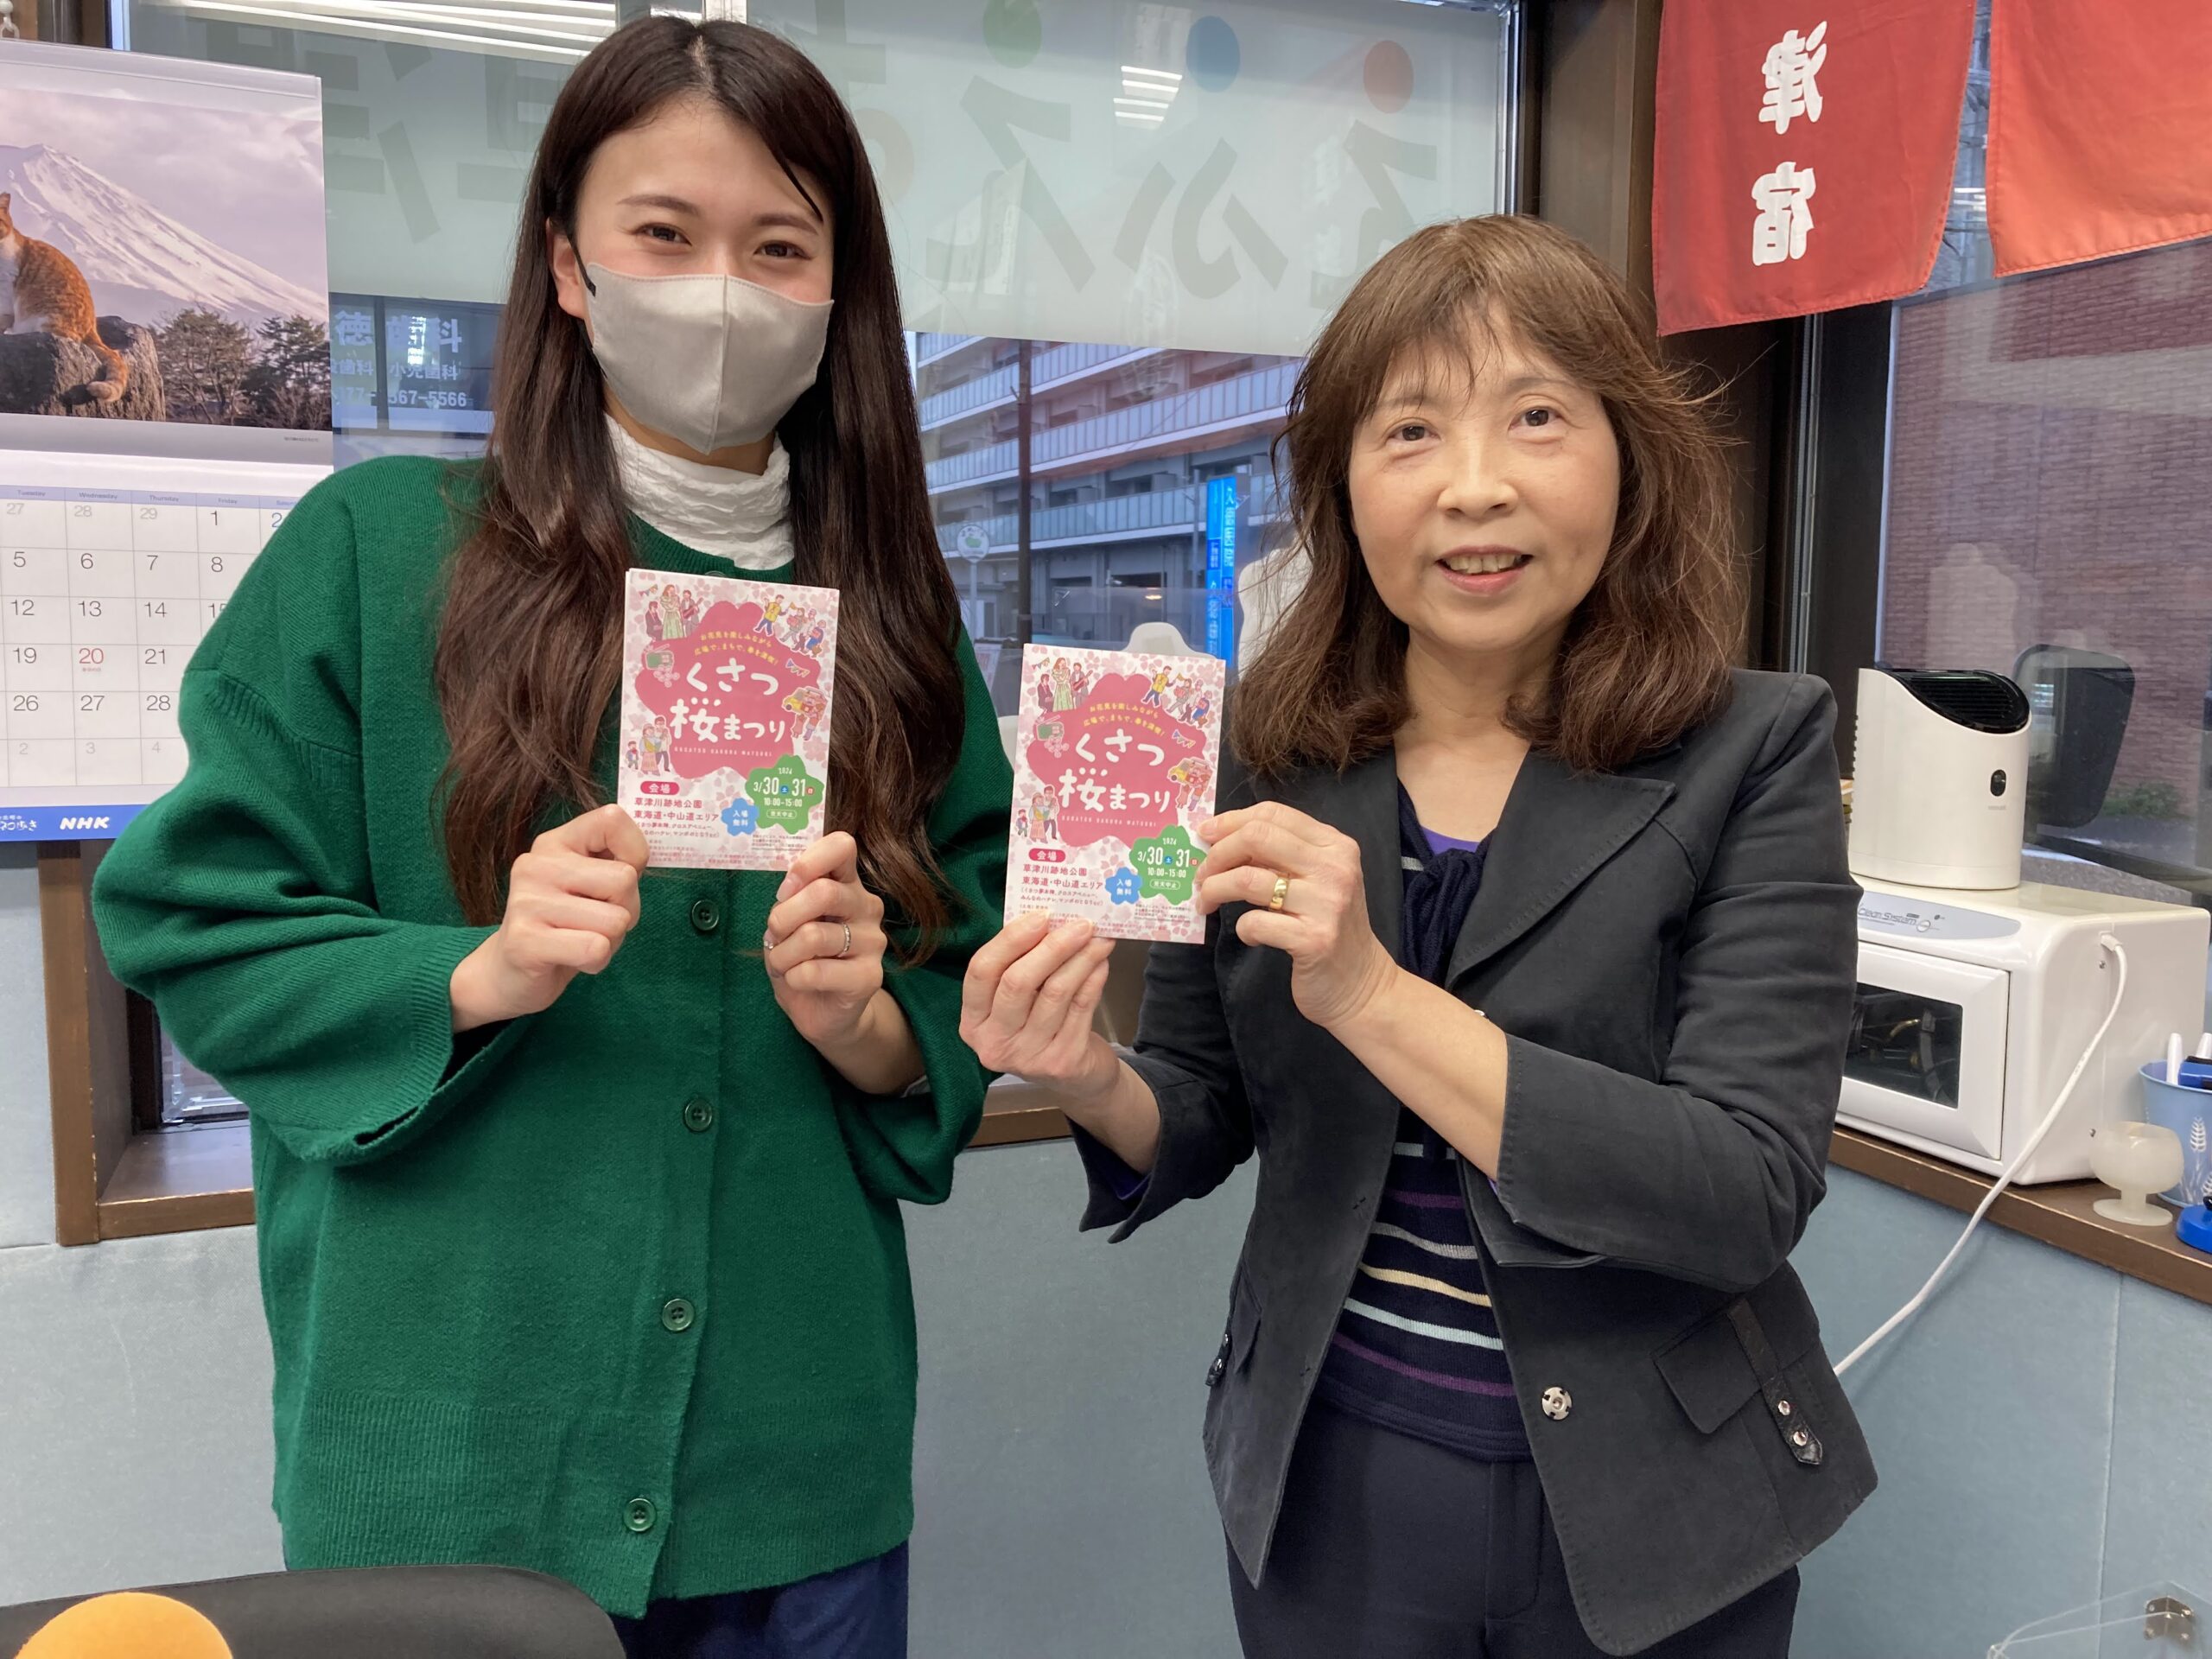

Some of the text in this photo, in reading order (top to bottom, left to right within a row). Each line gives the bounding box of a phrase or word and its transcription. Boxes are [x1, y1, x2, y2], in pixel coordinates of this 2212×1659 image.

[79, 492, 118, 500] Wednesday
[7, 503, 283, 528] 27 28 29 1 2
[13, 551, 223, 573] 5 6 7 8
[11, 601, 35, 616] 12
[79, 601, 102, 617] 13
[145, 602, 168, 618] 14
[13, 648, 167, 664] 19 20 21
[686, 658, 779, 696] くさつ
[13, 695, 171, 711] 26 27 28
[670, 698, 785, 743] 桜まつり
[19, 741, 161, 755] 2 3 4
[1075, 728, 1165, 766] くさつ
[649, 783, 671, 793] 会場
[791, 779, 806, 797] 31
[1058, 768, 1171, 812] 桜まつり
[635, 798, 702, 809] 草津川跡地公園
[60, 817, 110, 830] NHK
[1037, 850, 1057, 861] 会場
[1176, 849, 1190, 868] 31
[1023, 863, 1087, 876] 草津川跡地公園
[1859, 907, 1882, 919] Clean
[1883, 912, 1916, 926] System
